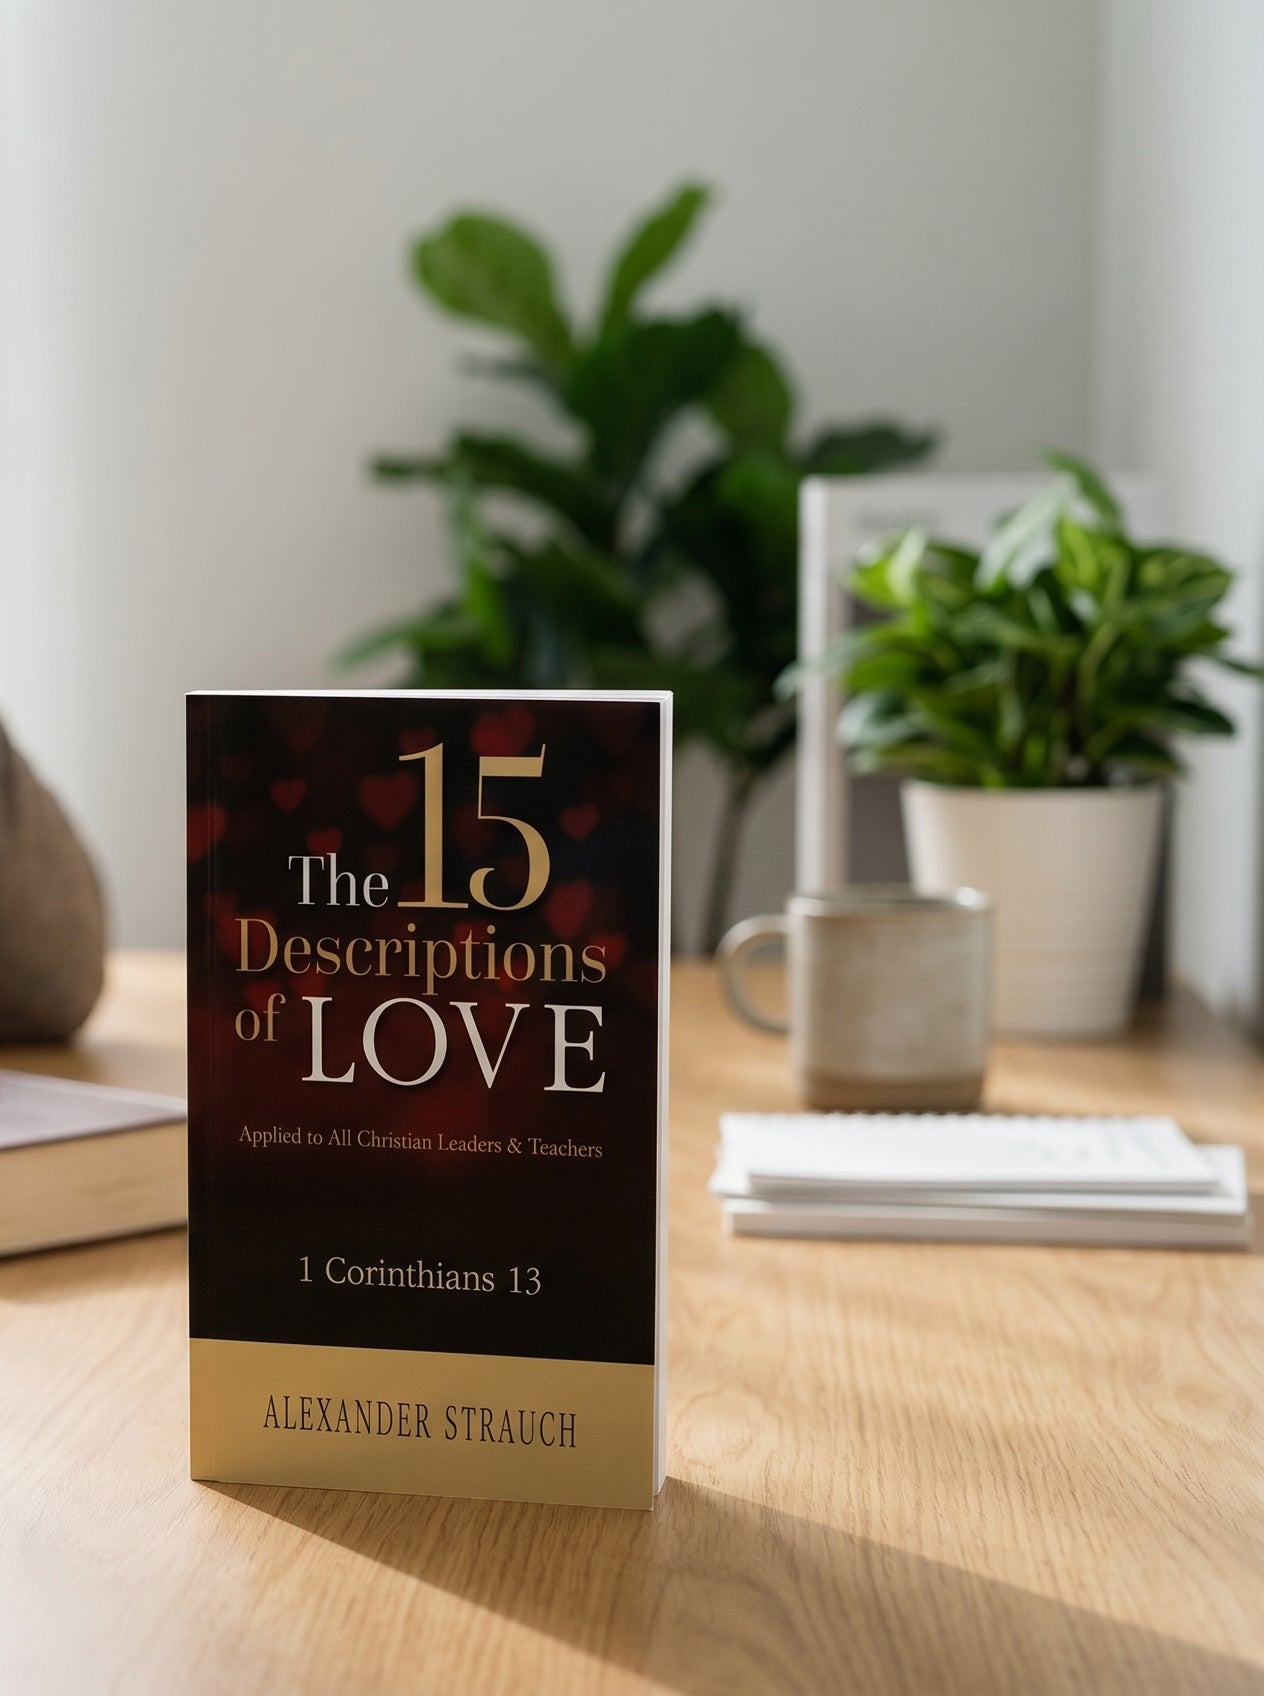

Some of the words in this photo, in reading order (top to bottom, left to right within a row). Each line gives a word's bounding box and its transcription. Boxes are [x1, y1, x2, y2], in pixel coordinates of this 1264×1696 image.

[288, 853, 389, 908] The
[397, 743, 551, 911] 15
[235, 918, 606, 996] Descriptions
[235, 993, 286, 1042] of
[301, 996, 606, 1093] LOVE
[239, 1125, 302, 1148] Applied
[307, 1130, 323, 1146] to
[328, 1128, 352, 1147] All
[357, 1129, 432, 1150] Christian
[437, 1133, 502, 1154] Leaders
[507, 1137, 523, 1155] &
[528, 1138, 603, 1158] Teachers
[299, 1256, 313, 1282] 1
[325, 1256, 495, 1292] Corinthians
[509, 1267, 542, 1296] 13
[263, 1394, 431, 1439] ALEXANDER
[444, 1405, 577, 1448] STRAUCH
